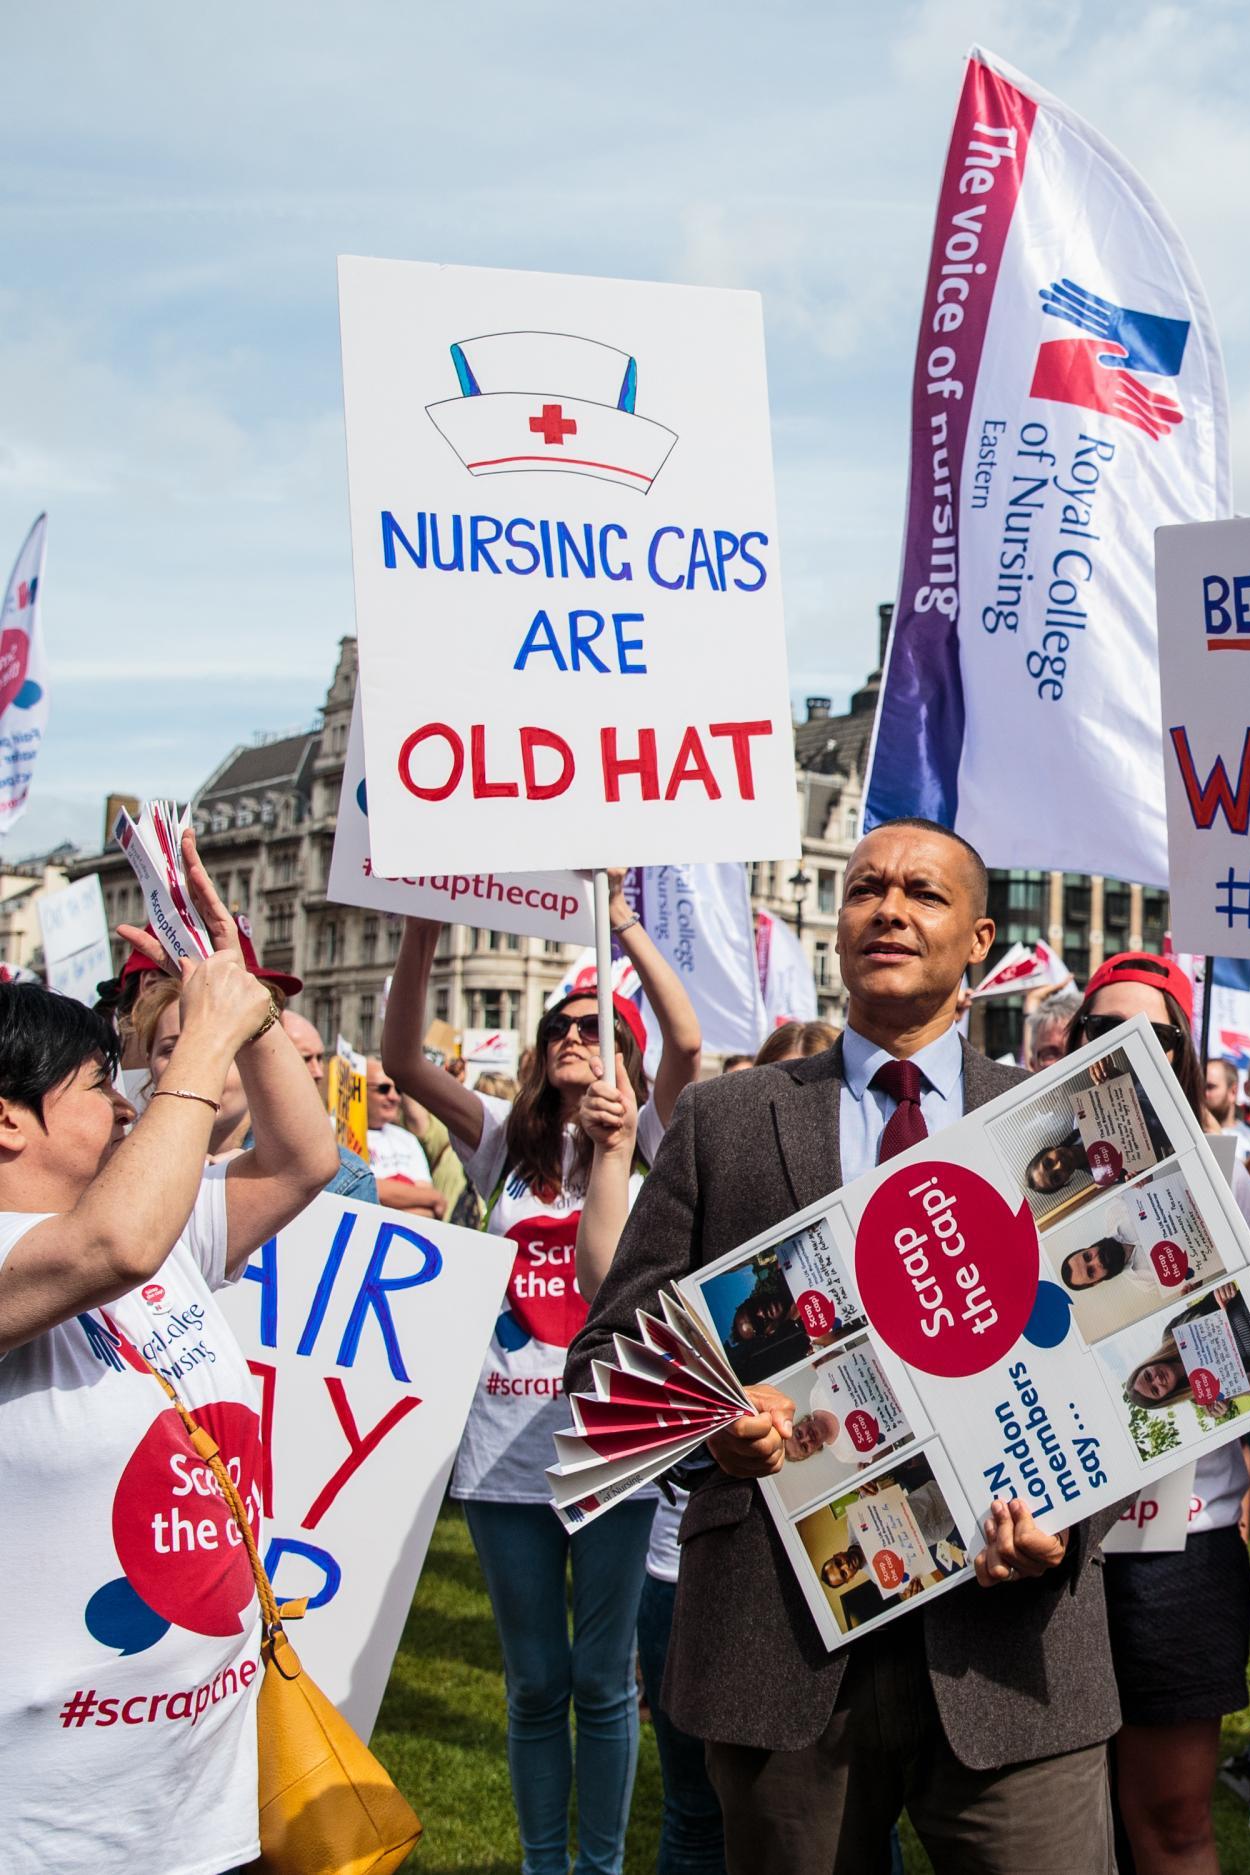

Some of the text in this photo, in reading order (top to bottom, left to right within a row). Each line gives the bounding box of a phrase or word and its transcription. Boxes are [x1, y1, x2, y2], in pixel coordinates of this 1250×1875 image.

[914, 121, 1018, 622] The voice of nursing
[970, 420, 1007, 510] Eastern
[981, 422, 1056, 635] of Nursing
[381, 511, 768, 591] NURSING CAPS
[1026, 432, 1116, 700] Royal College
[513, 609, 647, 674] ARE
[398, 719, 772, 802] OLD HAT
[362, 857, 579, 920] #rapthecap
[674, 900, 695, 972] College
[1099, 1145, 1114, 1176] the cap!
[814, 1252, 829, 1277] attract
[908, 1176, 999, 1335] the cap!
[1156, 1254, 1172, 1277] Scrap
[1163, 1245, 1181, 1277] the cap!
[514, 1270, 565, 1298] the
[828, 1287, 842, 1306] need
[894, 1227, 954, 1338] Scrap
[802, 1304, 818, 1327] Scrap
[809, 1294, 827, 1327] the cap!
[839, 1306, 851, 1321] We
[845, 1302, 857, 1315] for
[1193, 1379, 1205, 1398] Scrap
[1199, 1372, 1212, 1399] the cap!
[850, 1422, 865, 1443] Scrap
[856, 1414, 873, 1443] the cap!
[1009, 1361, 1081, 1503] members
[170, 1453, 241, 1497] Scrp
[995, 1401, 1054, 1519] London
[612, 1474, 644, 1496] Nursing
[151, 1508, 218, 1554] the
[877, 1561, 891, 1581] Scrap
[883, 1553, 898, 1581] the cap!
